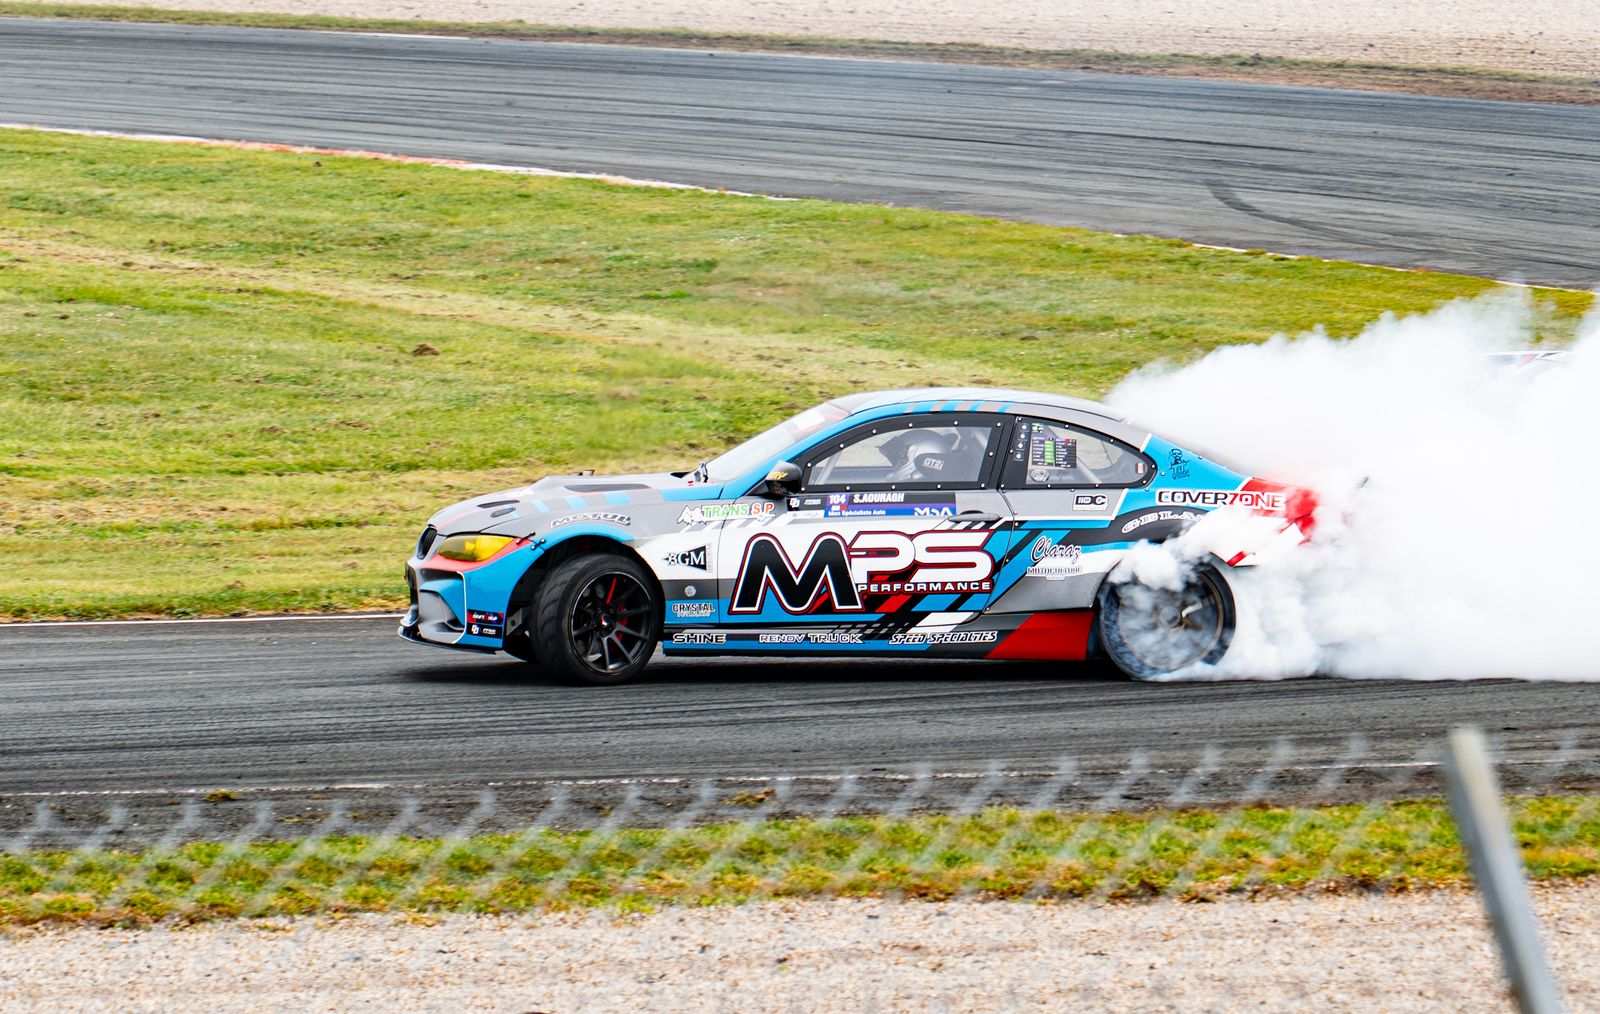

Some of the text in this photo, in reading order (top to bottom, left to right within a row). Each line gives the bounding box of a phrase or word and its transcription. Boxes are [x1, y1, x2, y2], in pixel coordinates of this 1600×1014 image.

[829, 494, 847, 504] 104
[1157, 490, 1284, 511] COVERZONE
[702, 504, 749, 519] TRANS
[550, 512, 632, 529] MOTUL
[728, 530, 996, 614] MPS
[857, 581, 992, 593] PERFORMANCE
[672, 603, 715, 612] CRYSTAL
[672, 633, 727, 644] SHINE
[759, 633, 863, 644] RENOV TRUCK
[888, 630, 998, 644] SPEED SPECIALTIES
